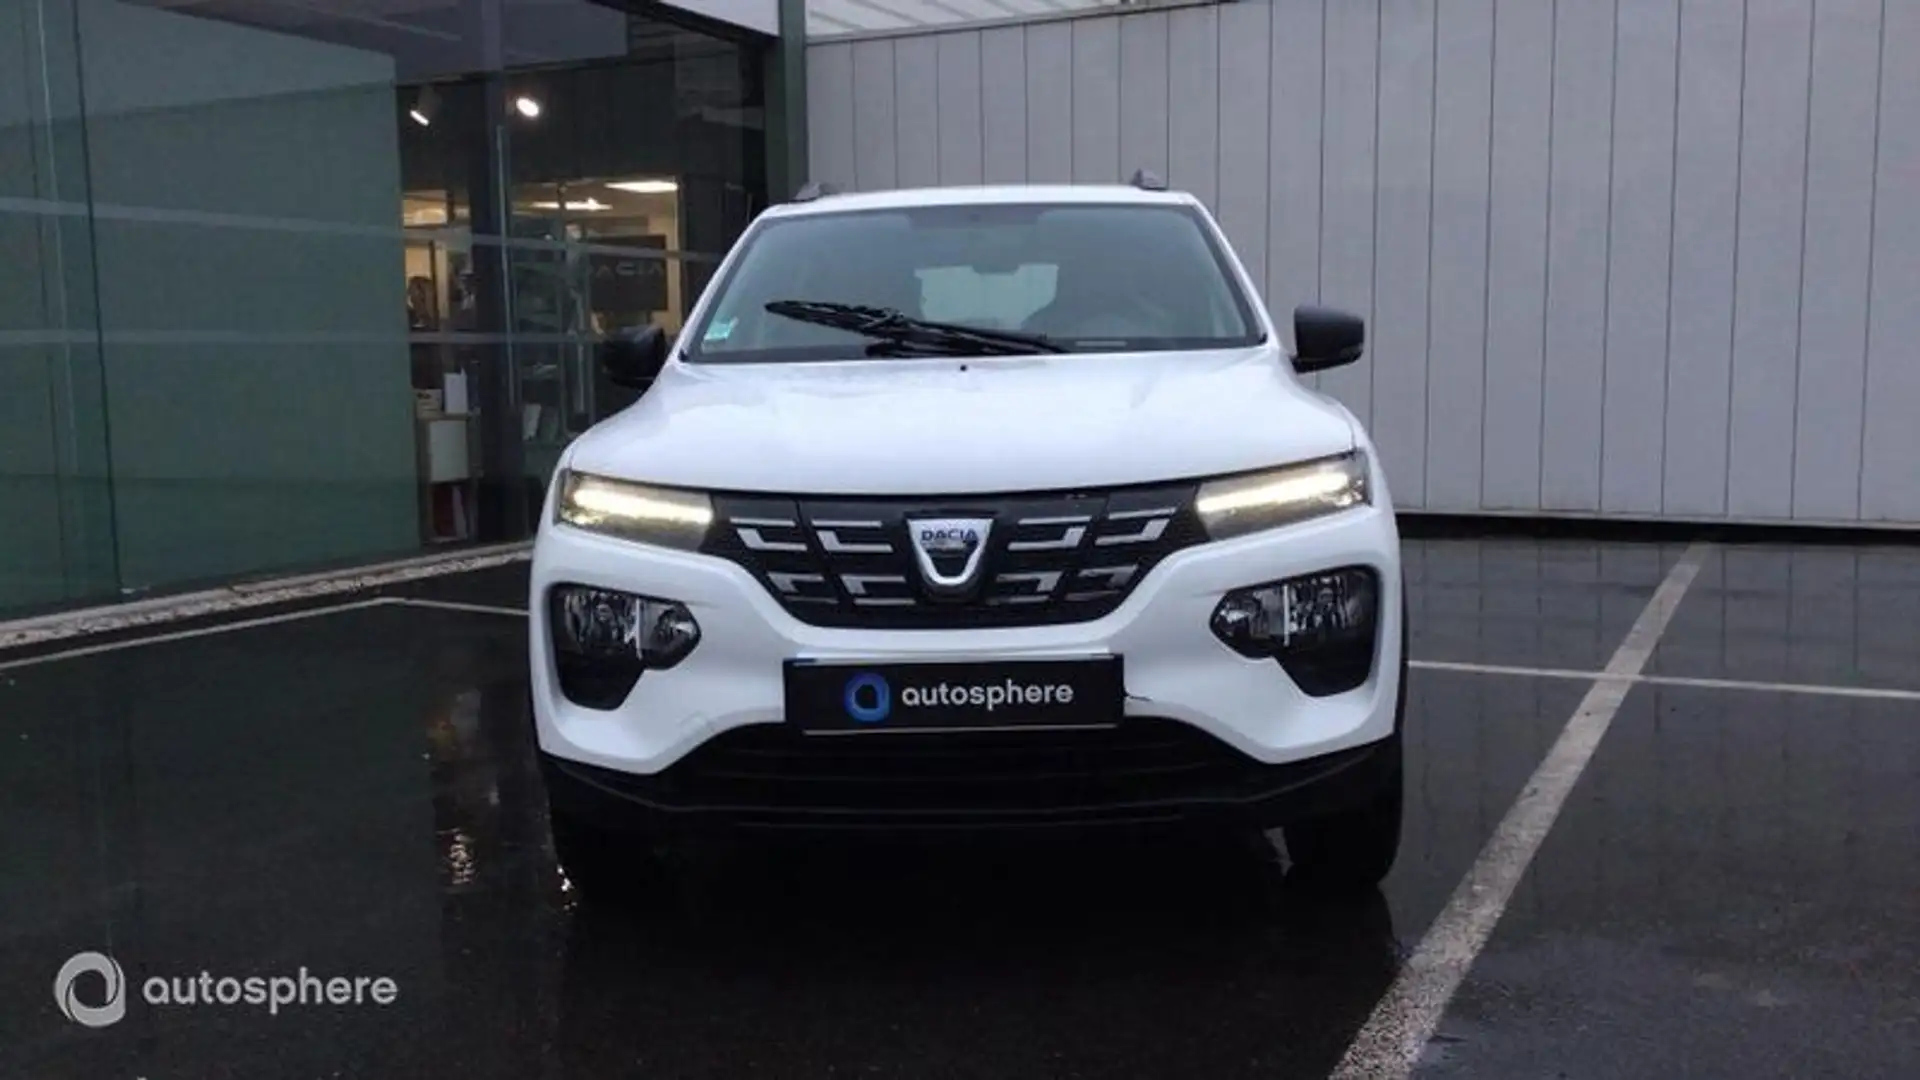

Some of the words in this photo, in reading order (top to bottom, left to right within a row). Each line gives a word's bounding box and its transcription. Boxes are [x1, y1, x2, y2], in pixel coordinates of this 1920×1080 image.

[588, 260, 664, 278] ACIA
[921, 528, 978, 541] DACIA
[902, 679, 1073, 710] autosphere
